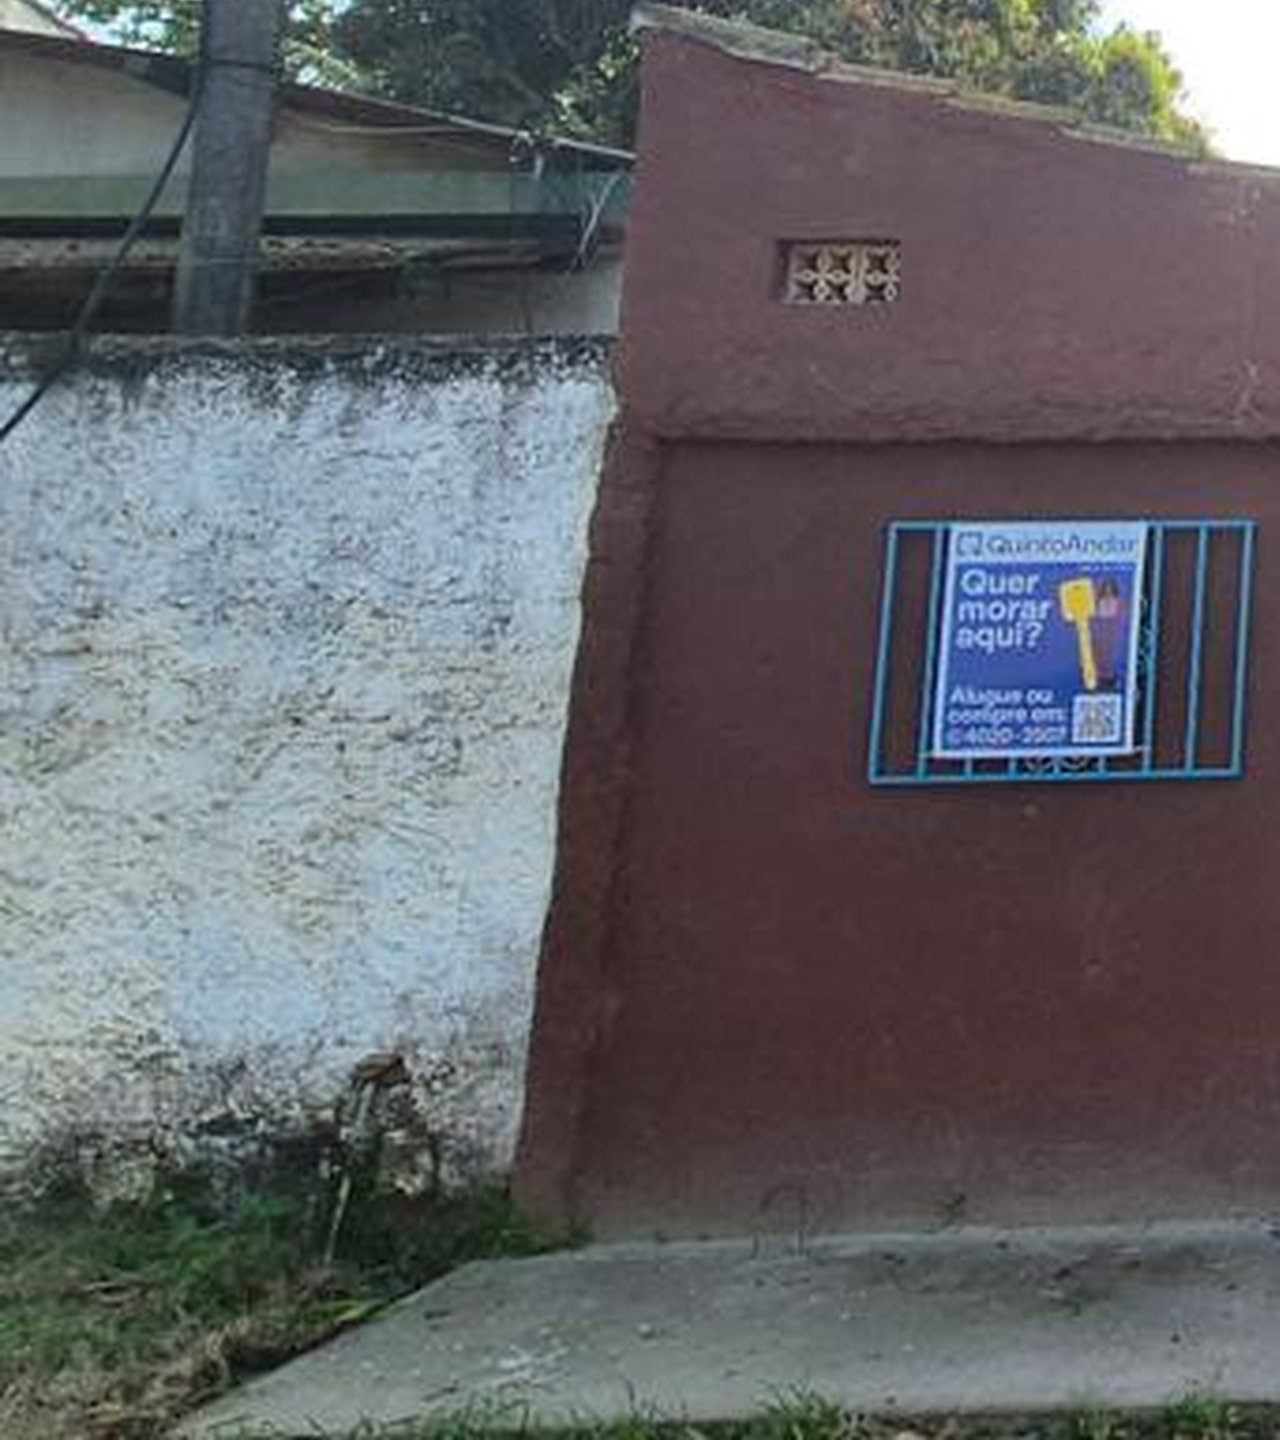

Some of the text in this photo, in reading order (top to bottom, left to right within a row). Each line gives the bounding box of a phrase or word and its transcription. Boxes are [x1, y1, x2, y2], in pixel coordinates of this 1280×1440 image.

[986, 533, 1138, 555] QuintoAndar
[960, 568, 1040, 597] Quer
[958, 598, 1051, 622] morar
[955, 621, 1044, 655] aqui?
[950, 685, 1054, 707] Alugue ou
